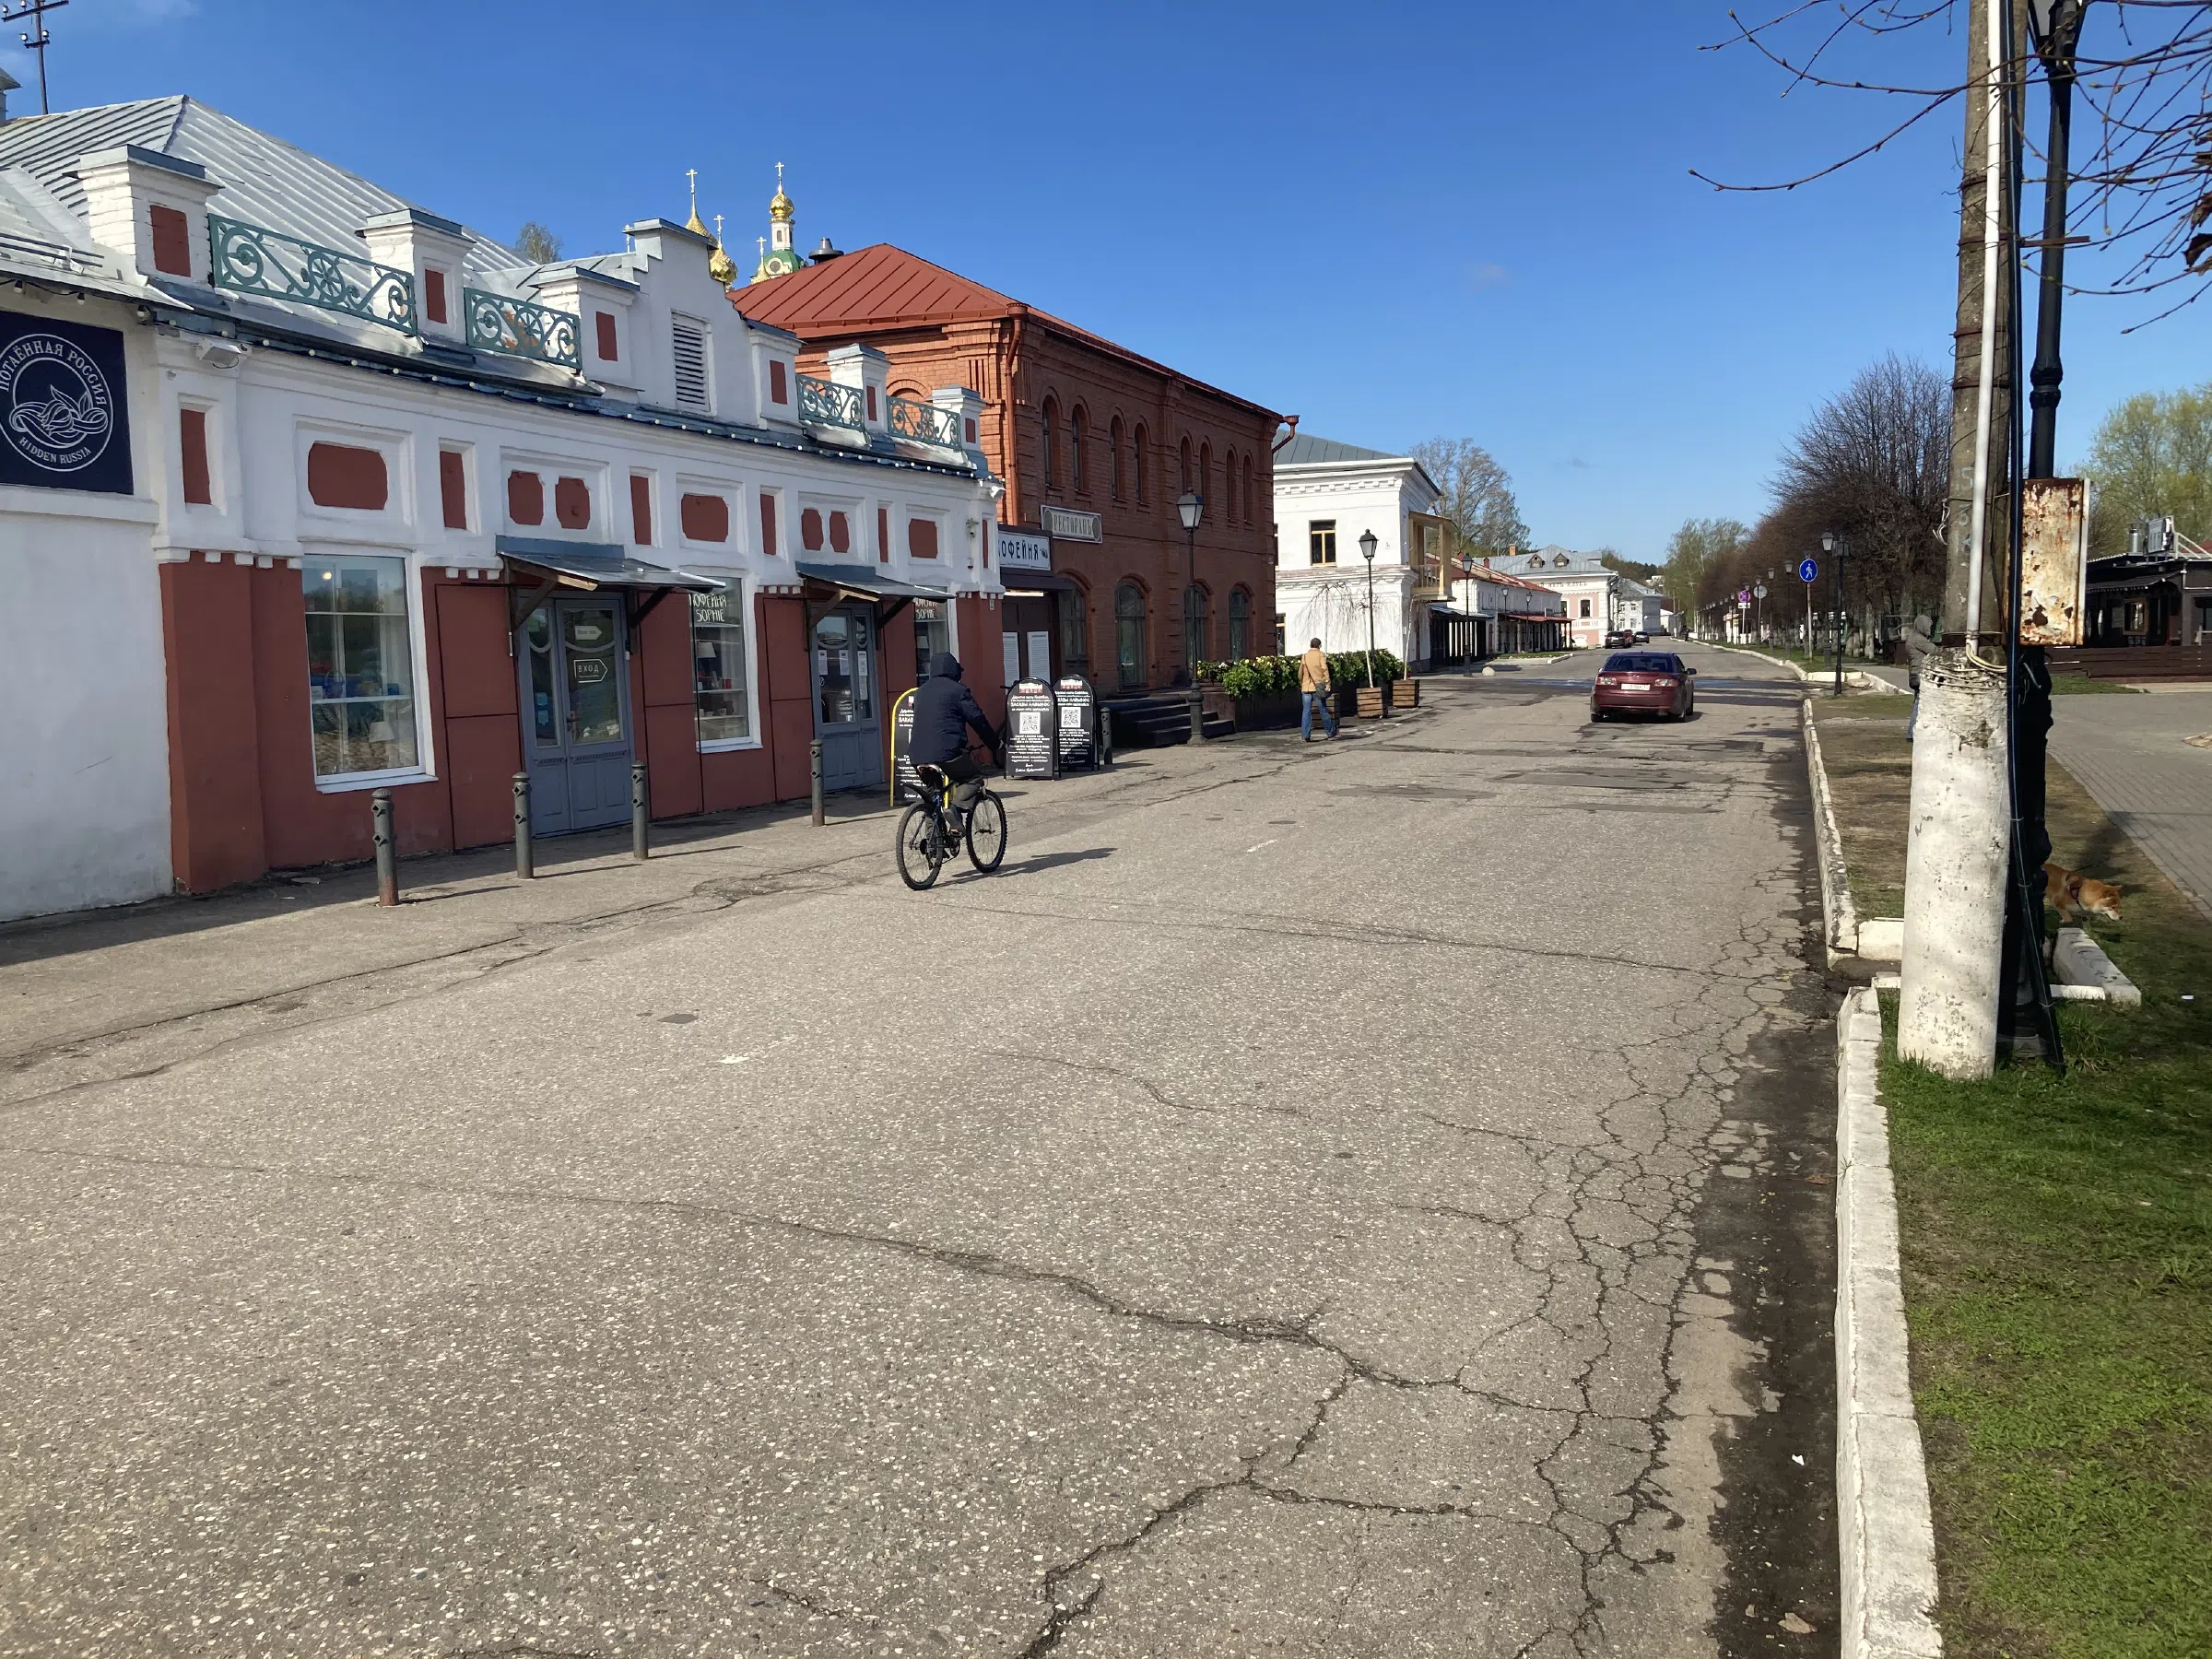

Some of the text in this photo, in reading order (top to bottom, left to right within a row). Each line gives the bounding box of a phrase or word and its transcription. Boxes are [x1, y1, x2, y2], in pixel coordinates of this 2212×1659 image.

[66, 349, 108, 406] РОССИЯ
[18, 436, 91, 464] HIDDEN RUSSIA
[1054, 514, 1092, 535] РЕСТОРАНЪ
[998, 539, 1039, 560] ОФЕЙНЯ
[696, 608, 725, 622] SOPHIE
[578, 665, 599, 673] ВХОД
